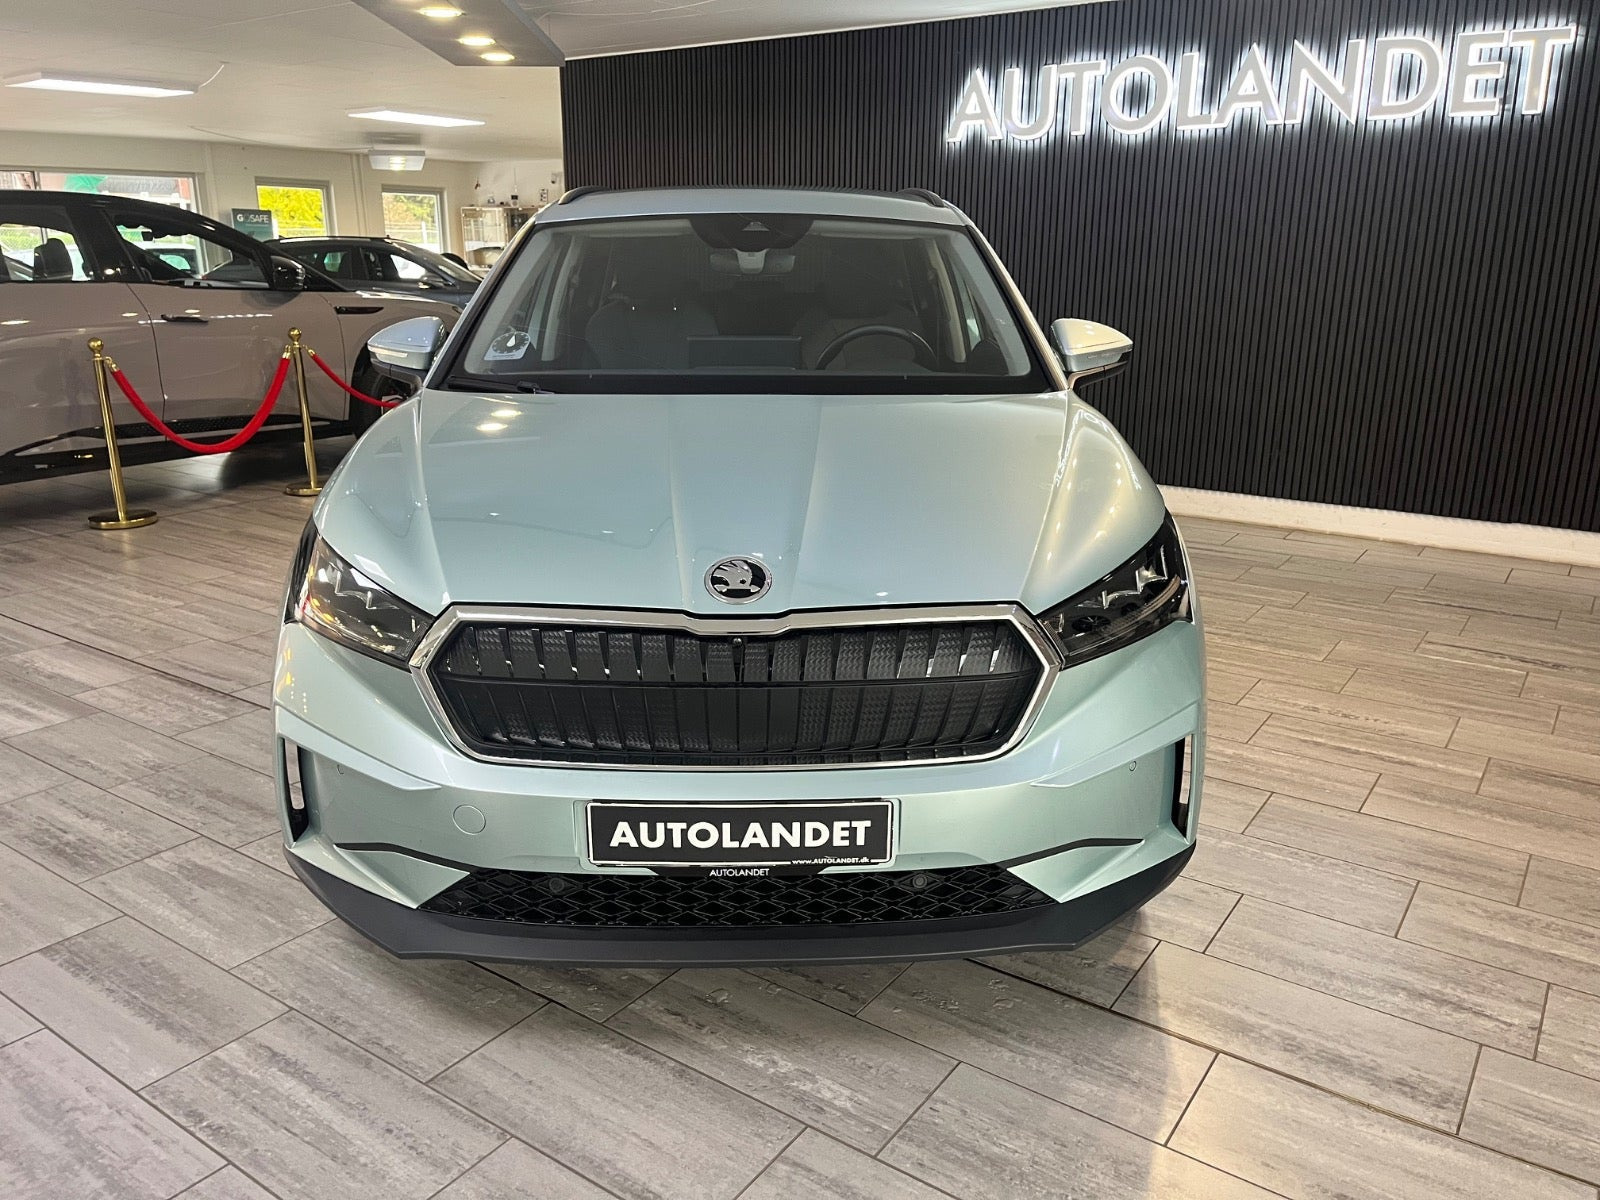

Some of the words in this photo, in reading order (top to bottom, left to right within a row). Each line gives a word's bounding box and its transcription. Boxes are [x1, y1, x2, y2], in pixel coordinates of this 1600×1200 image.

[946, 26, 1577, 142] AUTOLANDET
[609, 820, 872, 849] AUTOLANDET
[709, 868, 770, 877] AUTOLANDET
